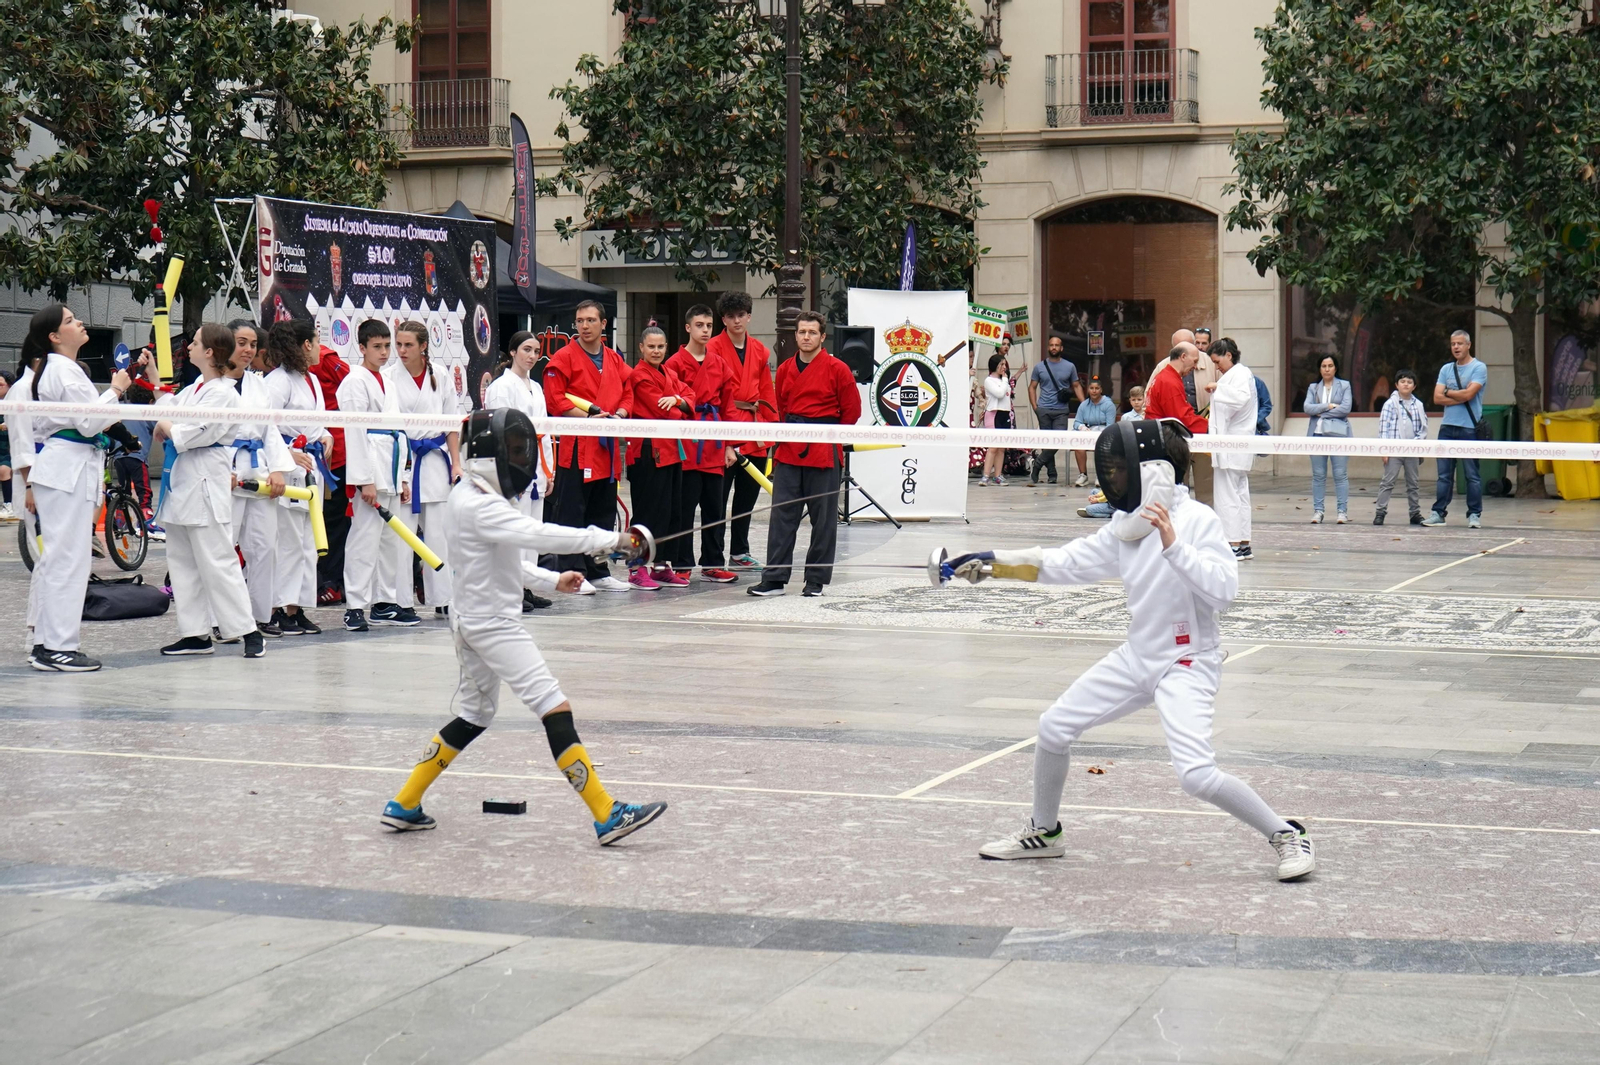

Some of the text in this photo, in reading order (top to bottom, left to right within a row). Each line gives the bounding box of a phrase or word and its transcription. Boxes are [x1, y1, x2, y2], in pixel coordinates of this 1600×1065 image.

[274, 240, 306, 258] Diputación
[273, 257, 307, 274] de Granada
[898, 353, 936, 371] ORIENTALES
